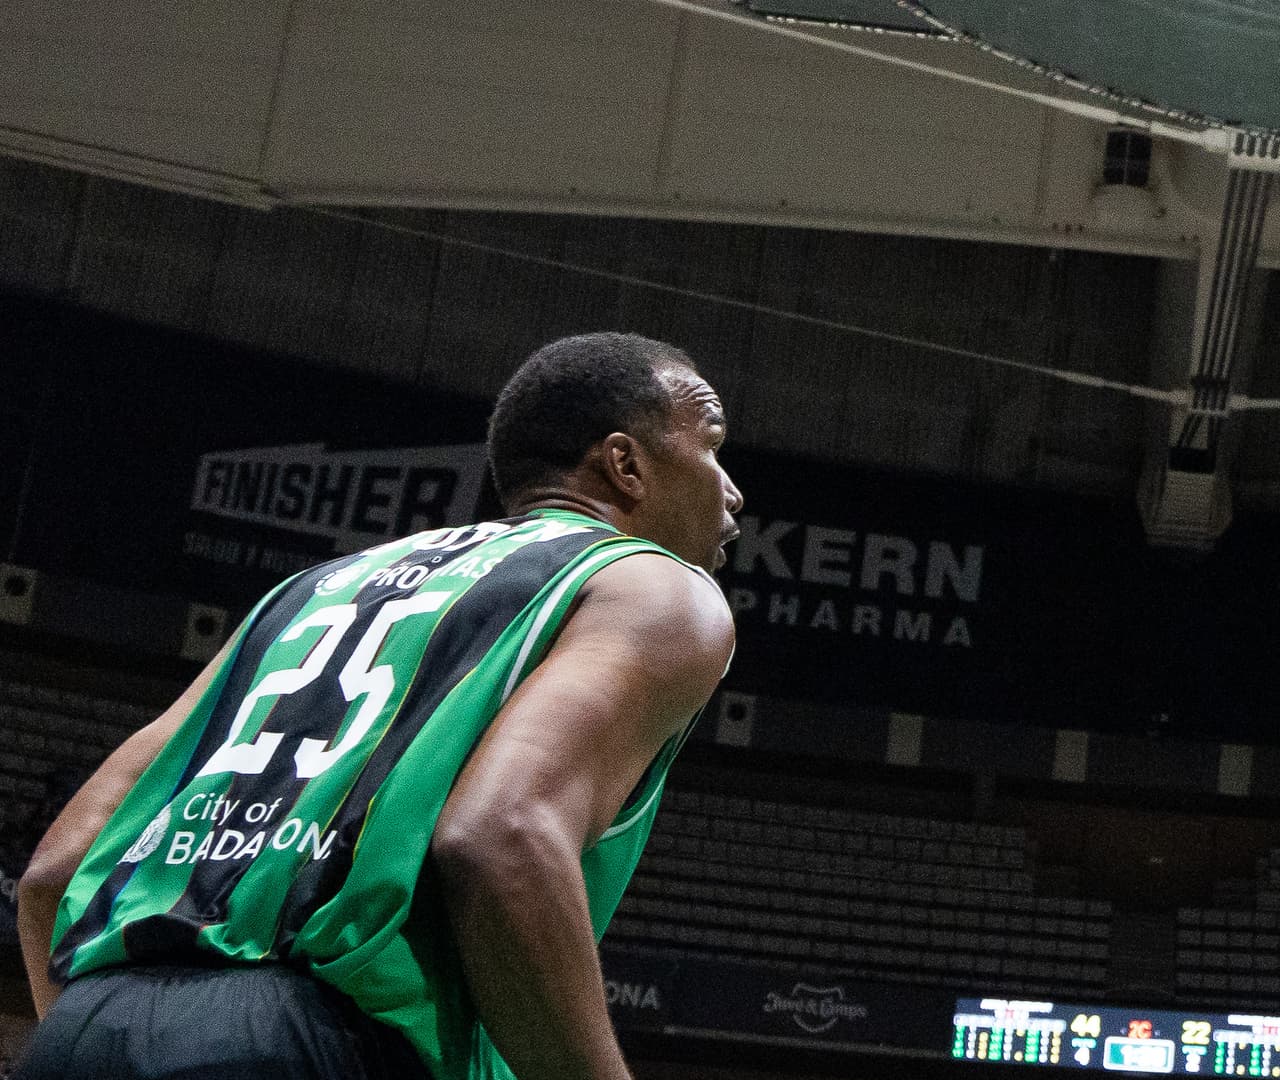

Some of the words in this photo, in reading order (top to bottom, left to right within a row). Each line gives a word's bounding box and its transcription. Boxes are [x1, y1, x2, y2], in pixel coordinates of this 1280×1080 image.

[203, 459, 458, 537] FINISHER
[733, 515, 984, 602] KERN
[729, 588, 972, 649] PHARMA
[195, 592, 453, 779] 25
[183, 792, 240, 826] City
[245, 798, 283, 823] of
[1071, 1014, 1101, 1038] 44
[1181, 1020, 1212, 1045] 22
